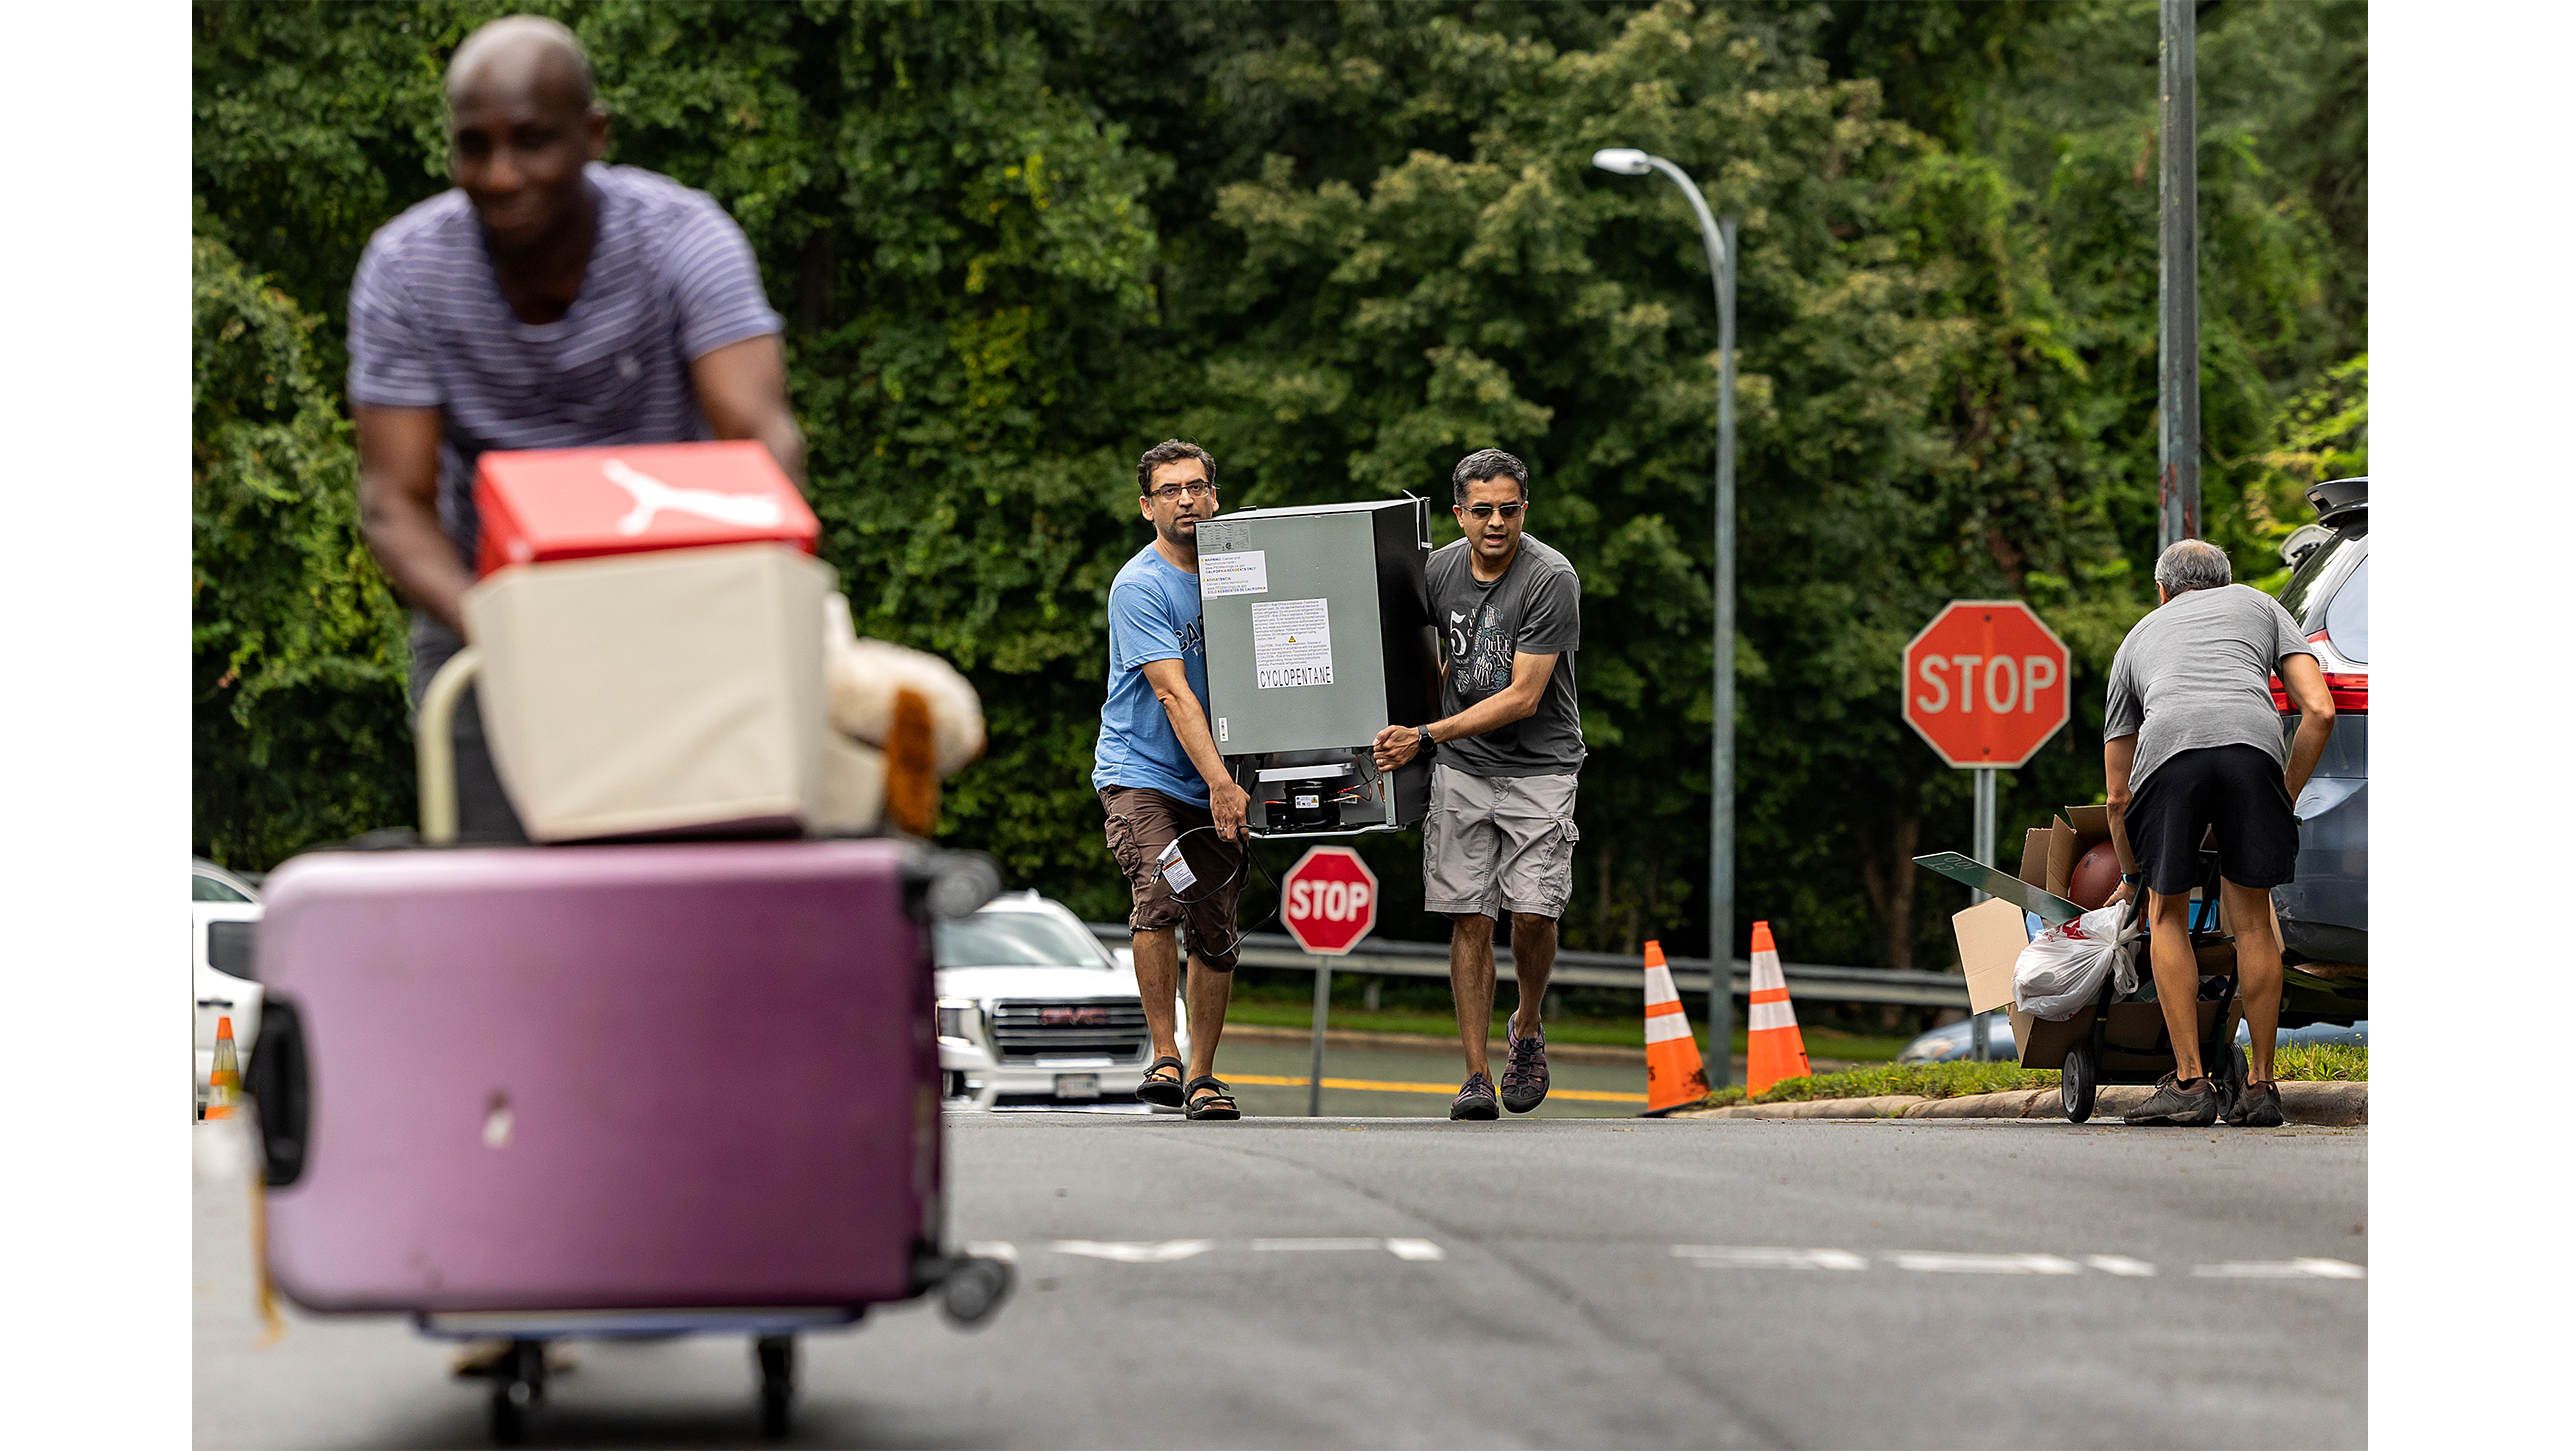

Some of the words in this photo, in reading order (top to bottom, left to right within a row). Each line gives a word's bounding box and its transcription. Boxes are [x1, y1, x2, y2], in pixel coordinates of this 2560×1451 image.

[1175, 614, 1203, 654] CA
[1450, 610, 1466, 656] 5
[1260, 667, 1331, 687] CYCLOPENTANE
[1917, 654, 2058, 714] STOP
[1289, 879, 1369, 922] STOP
